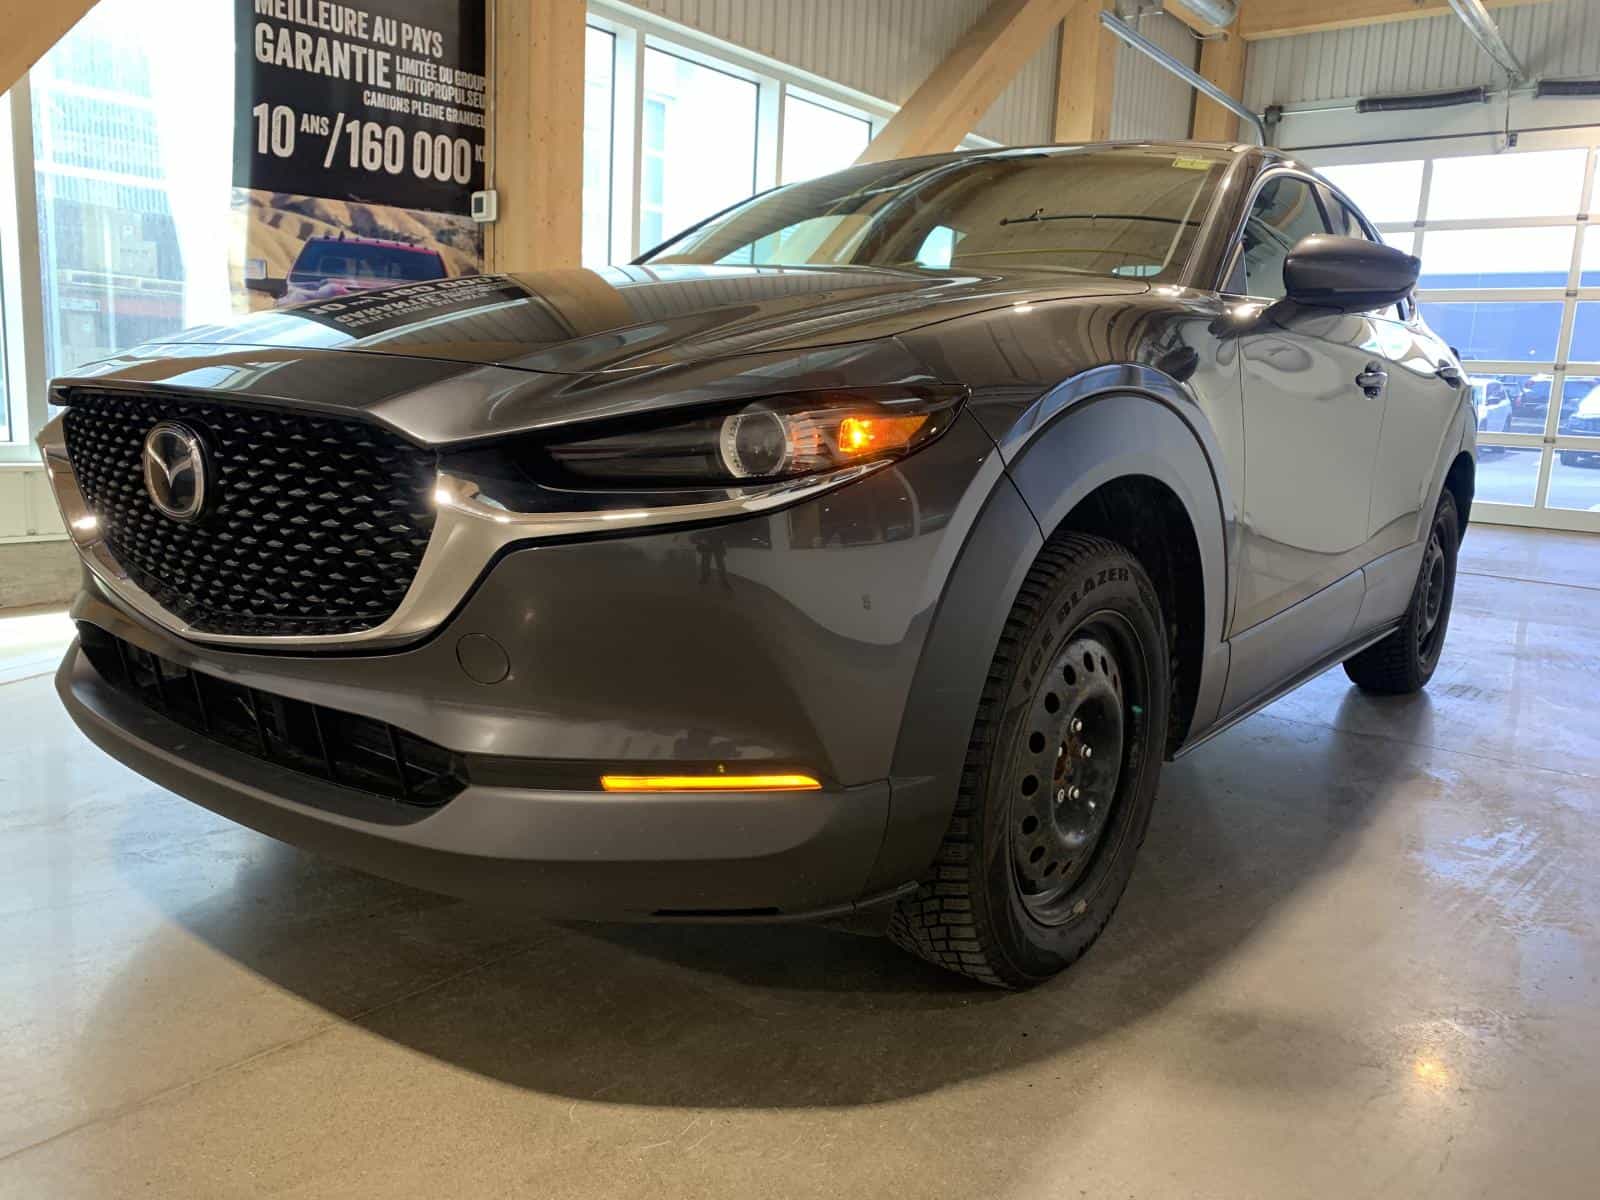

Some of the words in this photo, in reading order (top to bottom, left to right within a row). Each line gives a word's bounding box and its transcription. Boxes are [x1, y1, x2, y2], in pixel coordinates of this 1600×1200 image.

[255, 22, 391, 89] GARANTIE
[372, 16, 397, 46] AU
[401, 23, 443, 58] PAYS
[395, 58, 437, 81] LIMITÉE
[439, 66, 453, 85] DU
[363, 90, 410, 114] CAMIONS
[412, 100, 445, 122] PLEINE
[253, 103, 295, 158] 10
[412, 131, 471, 185] 000
